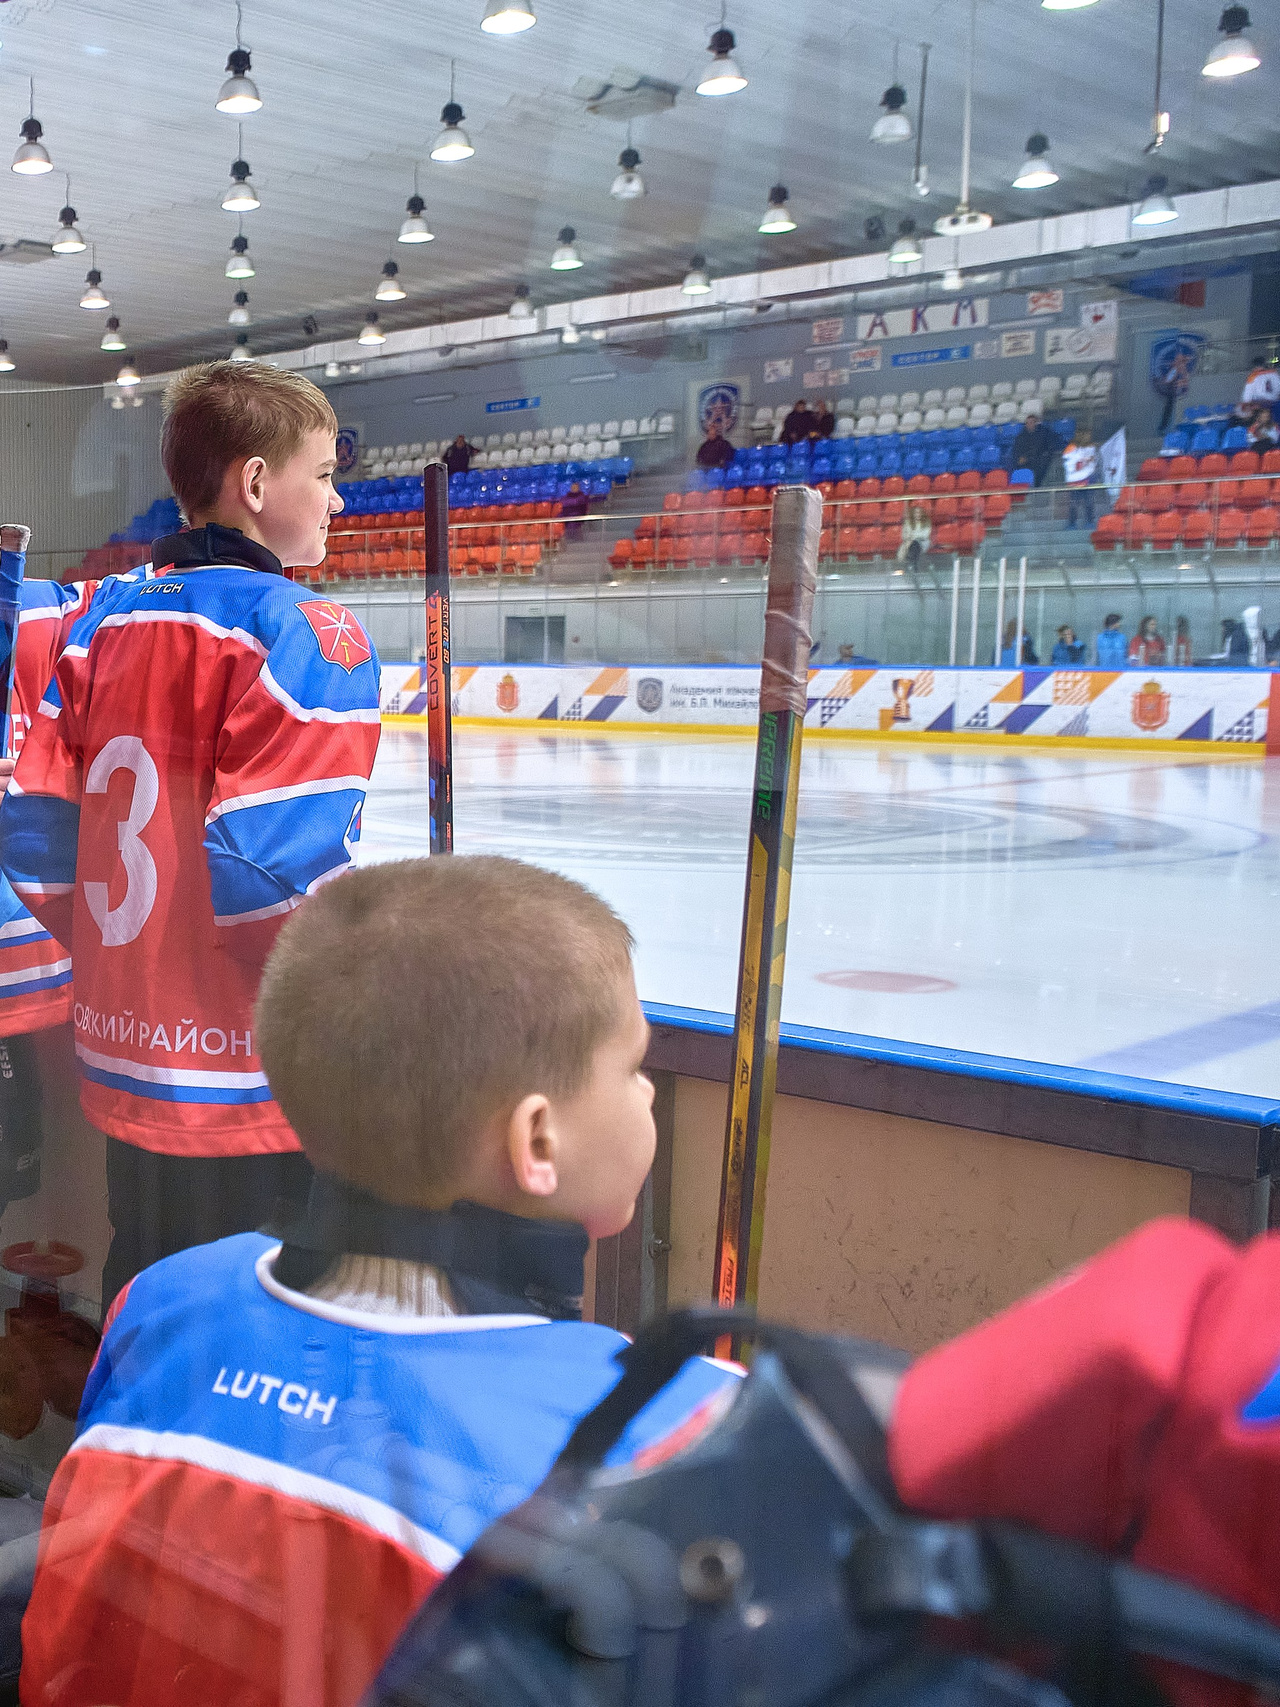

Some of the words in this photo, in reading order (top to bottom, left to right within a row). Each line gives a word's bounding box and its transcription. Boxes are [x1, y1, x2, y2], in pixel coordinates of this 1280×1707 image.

[139, 583, 184, 596] LUTCH
[428, 616, 439, 711] COVERT
[83, 735, 159, 946] 3
[139, 1018, 252, 1057] РАЙОН
[212, 1366, 338, 1425] LUTCH
